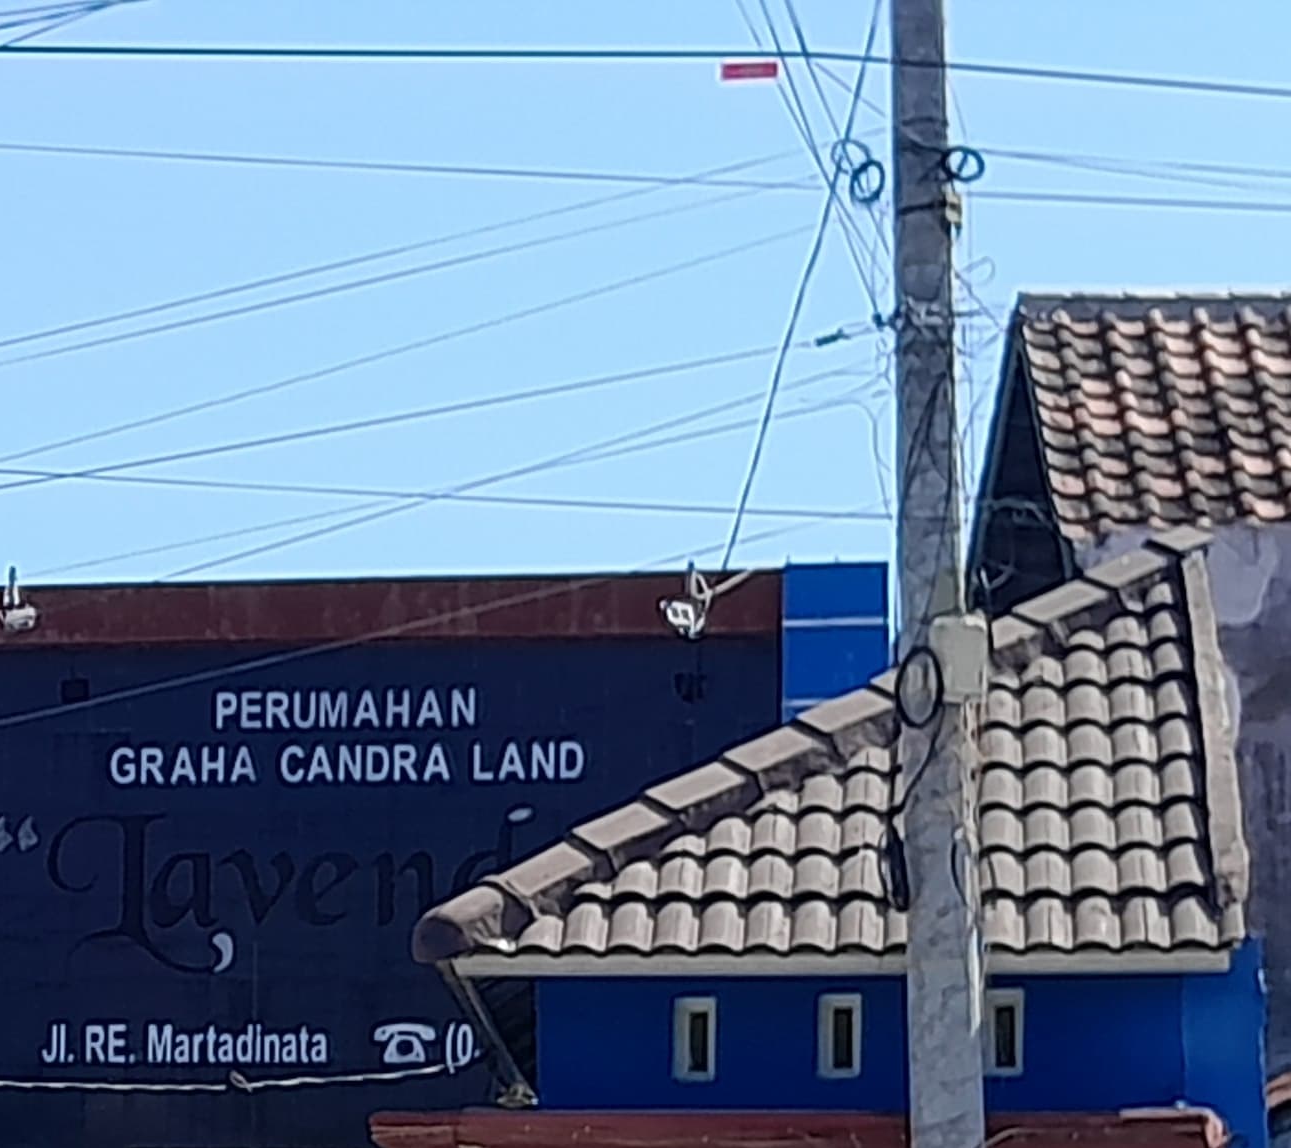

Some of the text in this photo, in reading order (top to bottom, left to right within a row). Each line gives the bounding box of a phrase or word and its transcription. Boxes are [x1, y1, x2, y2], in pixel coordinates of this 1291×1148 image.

[215, 687, 476, 730] PERUMAHAN
[109, 740, 585, 785] GRAHA CANDRA LAND
[85, 1023, 136, 1064] RE.
[147, 1023, 328, 1064] Martadinata
[444, 1021, 482, 1074] (0
